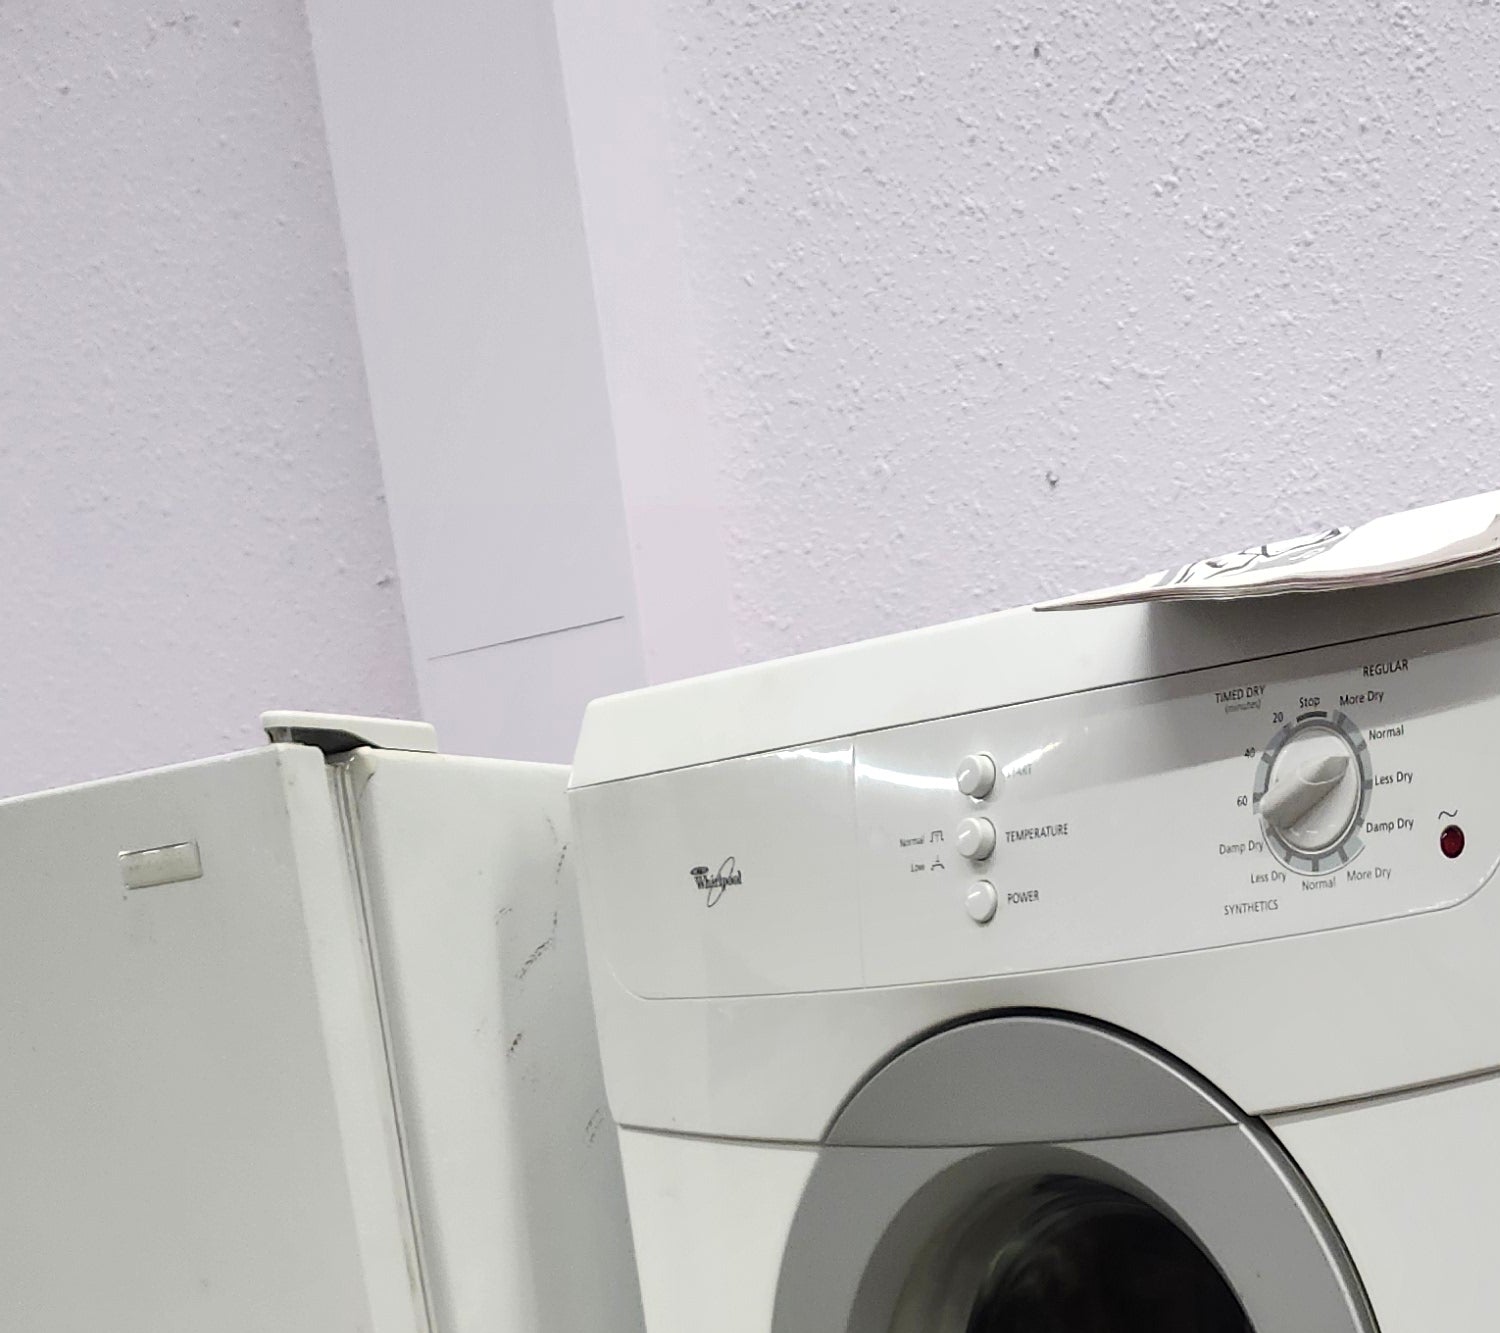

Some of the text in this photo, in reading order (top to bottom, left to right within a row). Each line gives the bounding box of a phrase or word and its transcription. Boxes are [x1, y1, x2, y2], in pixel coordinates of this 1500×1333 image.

[1362, 659, 1409, 677] REGULAR
[1214, 685, 1266, 704] TIMED DRY
[1339, 690, 1384, 706] More Dry
[1299, 697, 1321, 709] Stop
[1272, 712, 1284, 724] 20
[1369, 725, 1405, 741] Normal
[1244, 747, 1256, 758] 40
[1374, 771, 1414, 786] Less Dry
[1236, 795, 1249, 807] 60
[1005, 823, 1069, 843] TEMPERATURE
[1366, 817, 1415, 834] Damp Dry
[1219, 840, 1265, 855] Damp Dry
[910, 863, 926, 873] Low
[1346, 866, 1392, 882] More Dry
[692, 864, 743, 895] Whirlpool
[1250, 870, 1287, 884] Less Dry
[1301, 876, 1337, 892] Normal
[1007, 889, 1040, 905] POWER
[1223, 899, 1280, 916] SYNTHETICS
